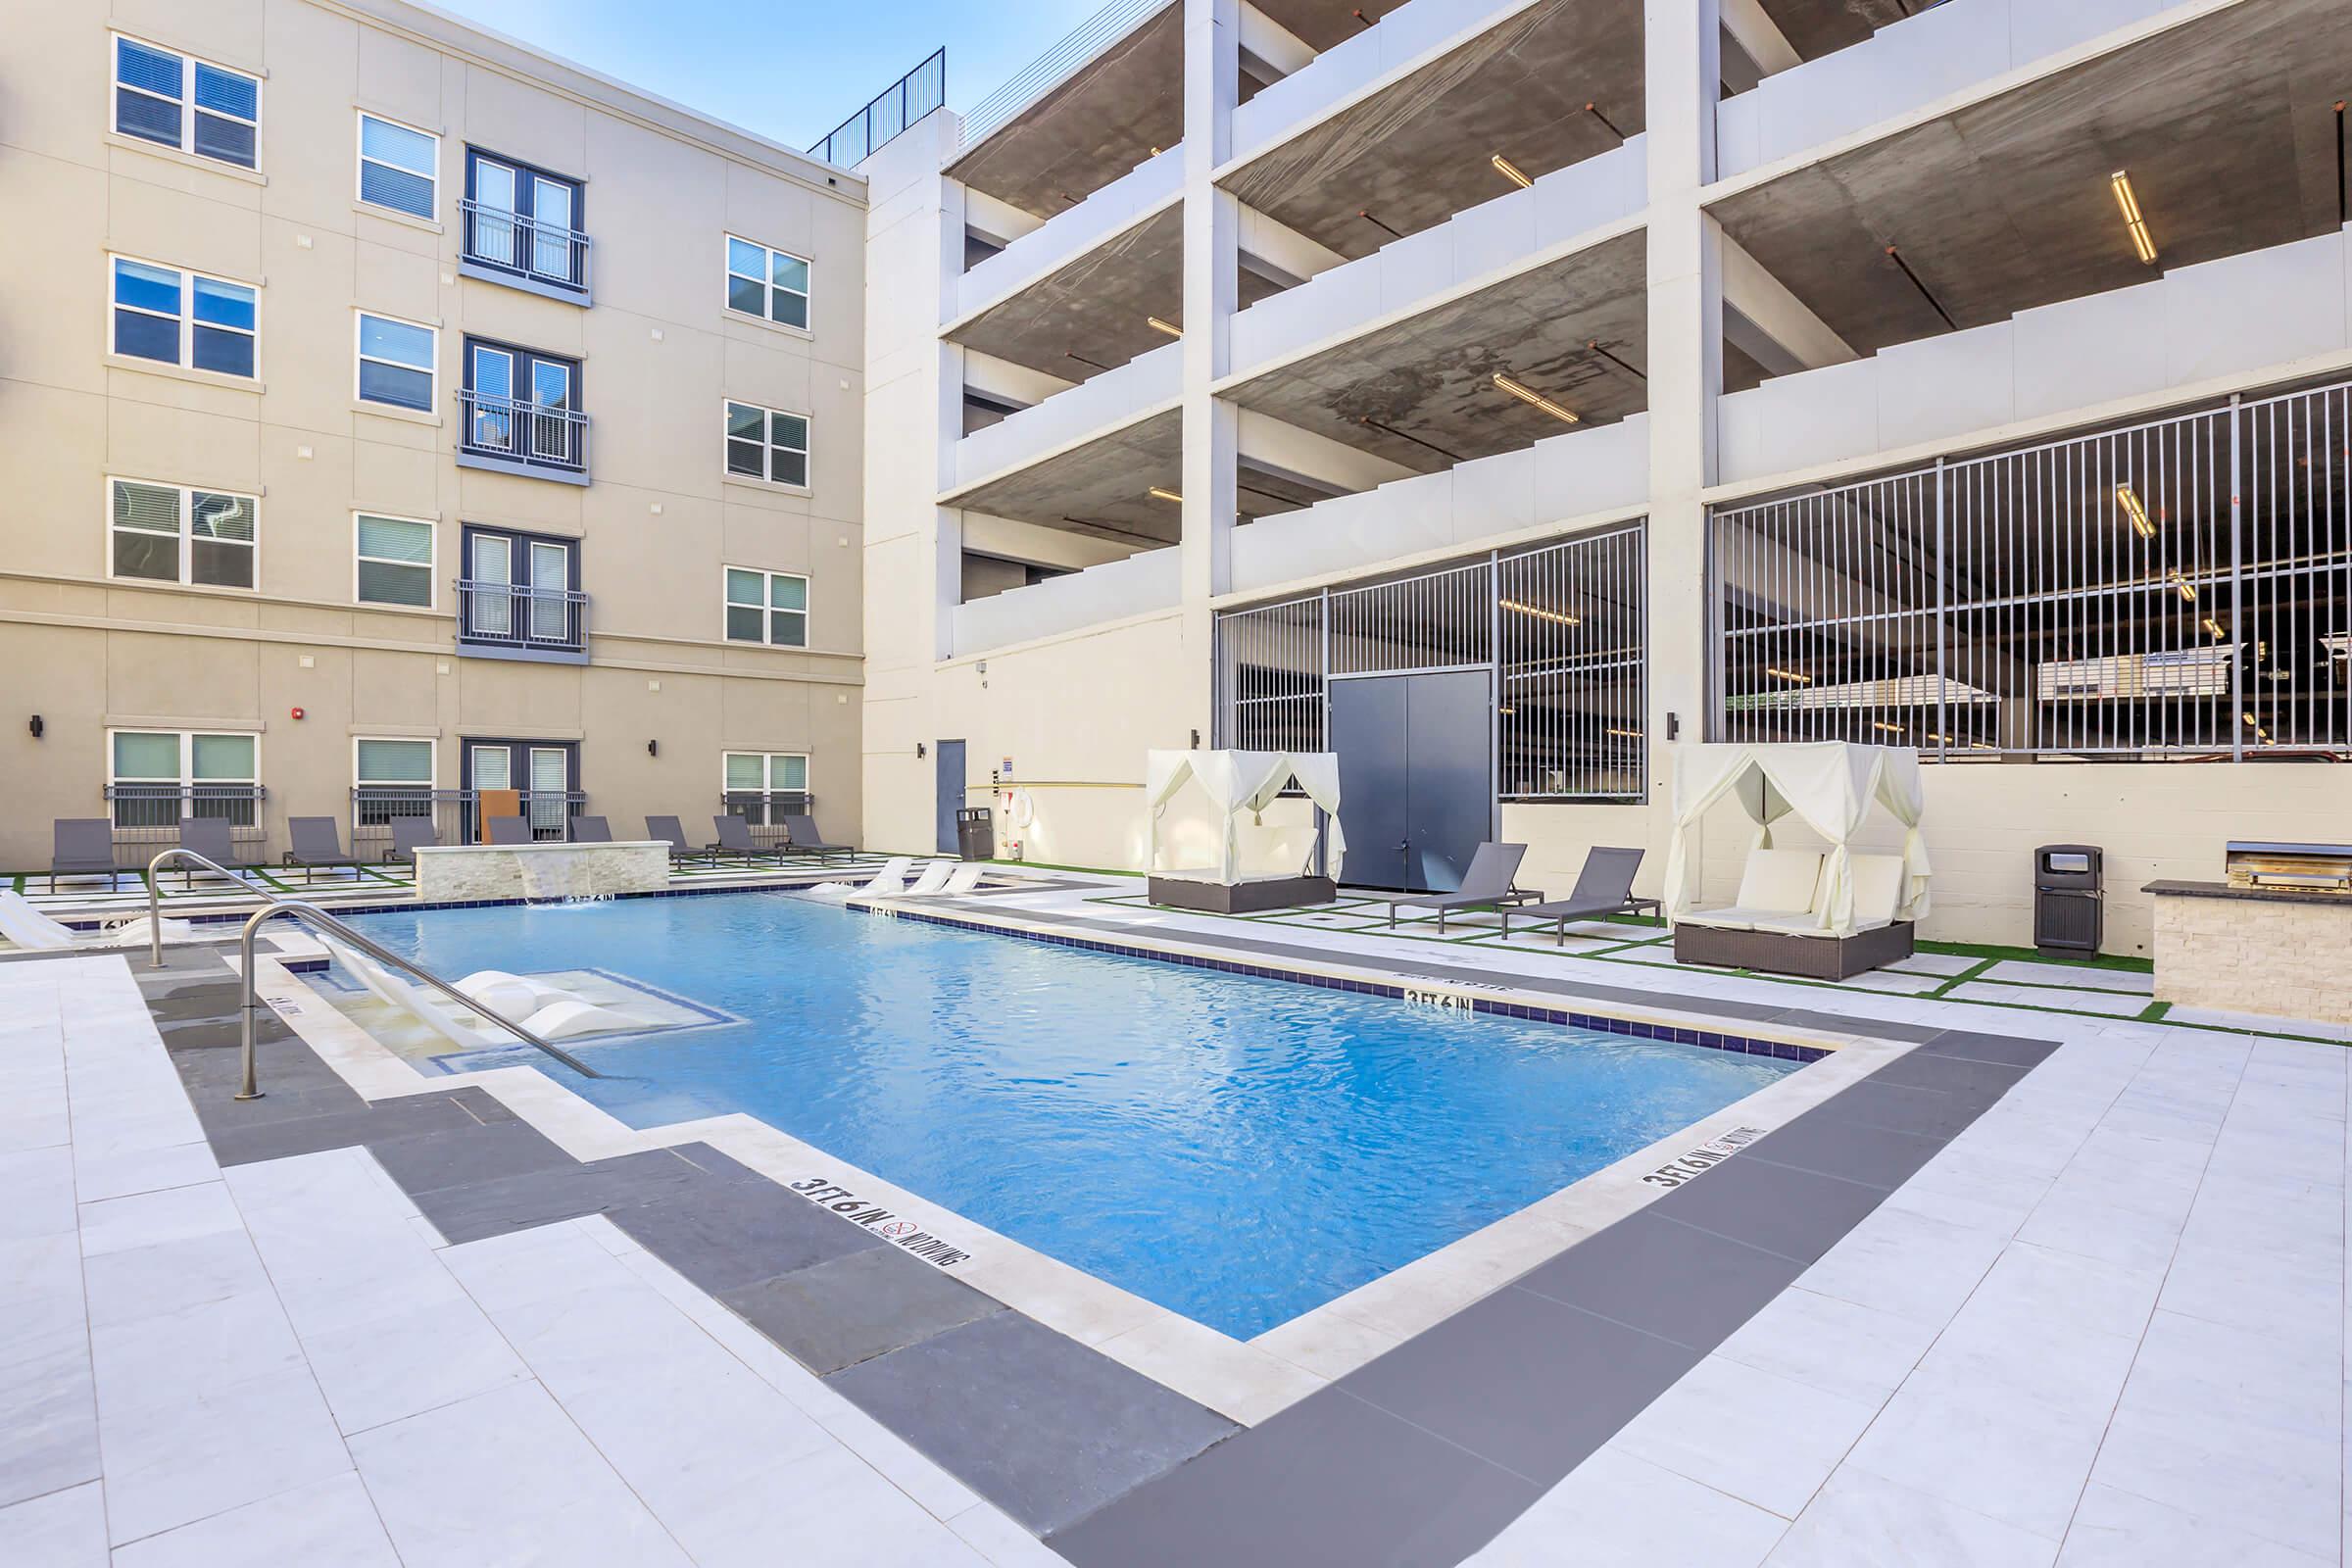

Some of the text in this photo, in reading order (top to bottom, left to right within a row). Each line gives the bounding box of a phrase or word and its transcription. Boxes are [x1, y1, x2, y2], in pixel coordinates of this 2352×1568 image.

[1407, 990, 1470, 1011] 3 FT 6 IN
[1642, 1175, 1682, 1188] 3
[1677, 1156, 1712, 1169] 6
[790, 1178, 829, 1191] 3
[830, 1200, 871, 1212] 6
[895, 1232, 934, 1247] NO
[908, 1239, 971, 1267] DIVING
